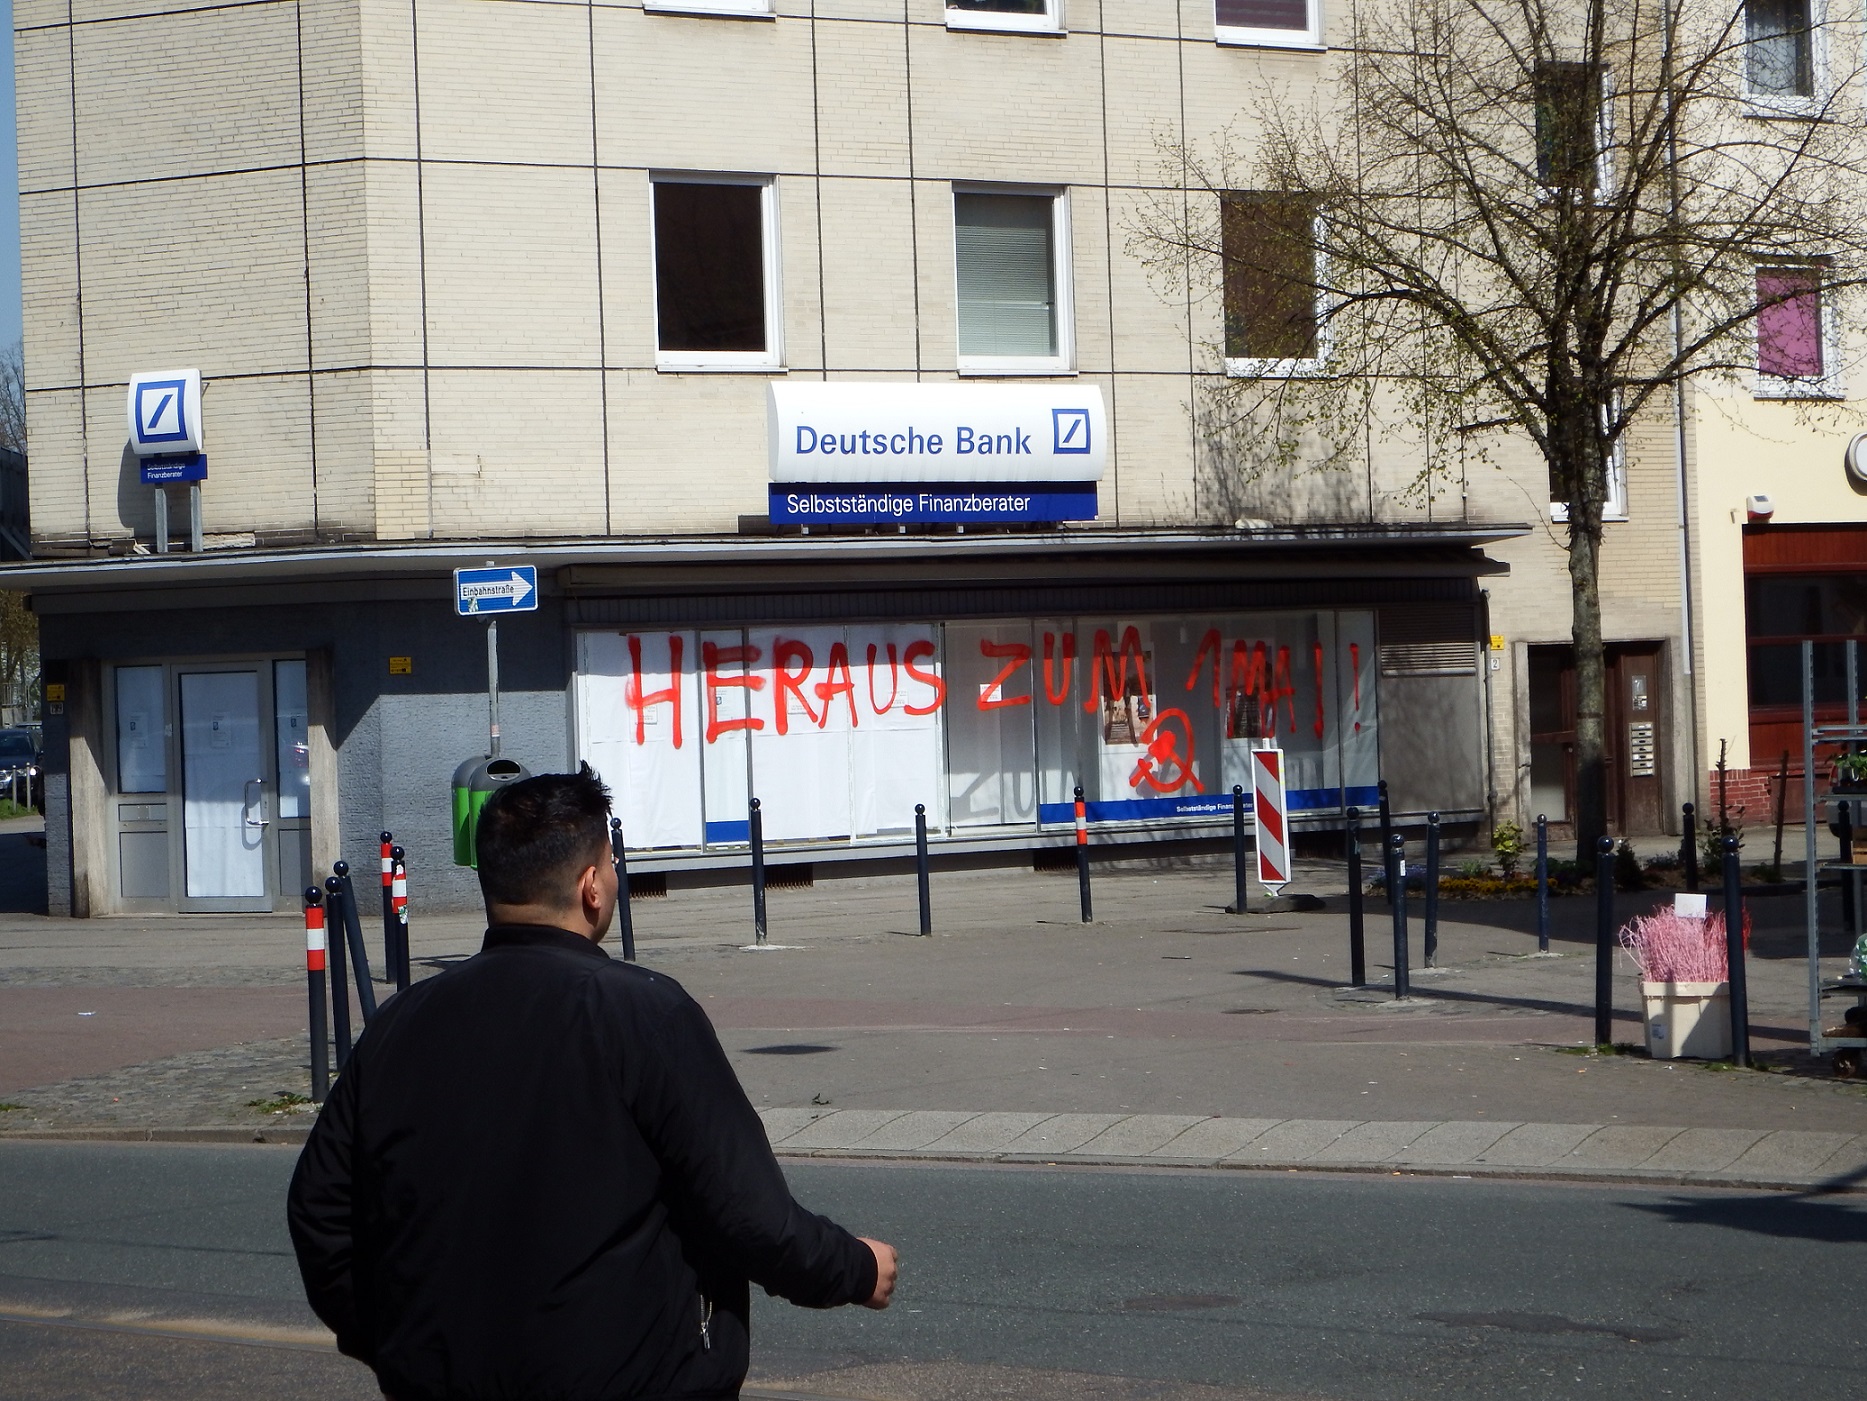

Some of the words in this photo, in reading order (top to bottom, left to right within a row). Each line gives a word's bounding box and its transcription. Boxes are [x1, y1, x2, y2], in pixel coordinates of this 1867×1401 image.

[796, 425, 943, 455] Deutsche
[956, 426, 1032, 455] Bank
[147, 471, 183, 479] Finanzberater
[787, 493, 914, 518] Selbstständige
[918, 493, 1031, 512] Finanzberater
[462, 584, 515, 598] Einbahnstraße
[624, 633, 947, 750] HERAUS
[976, 625, 1152, 714] ZUM
